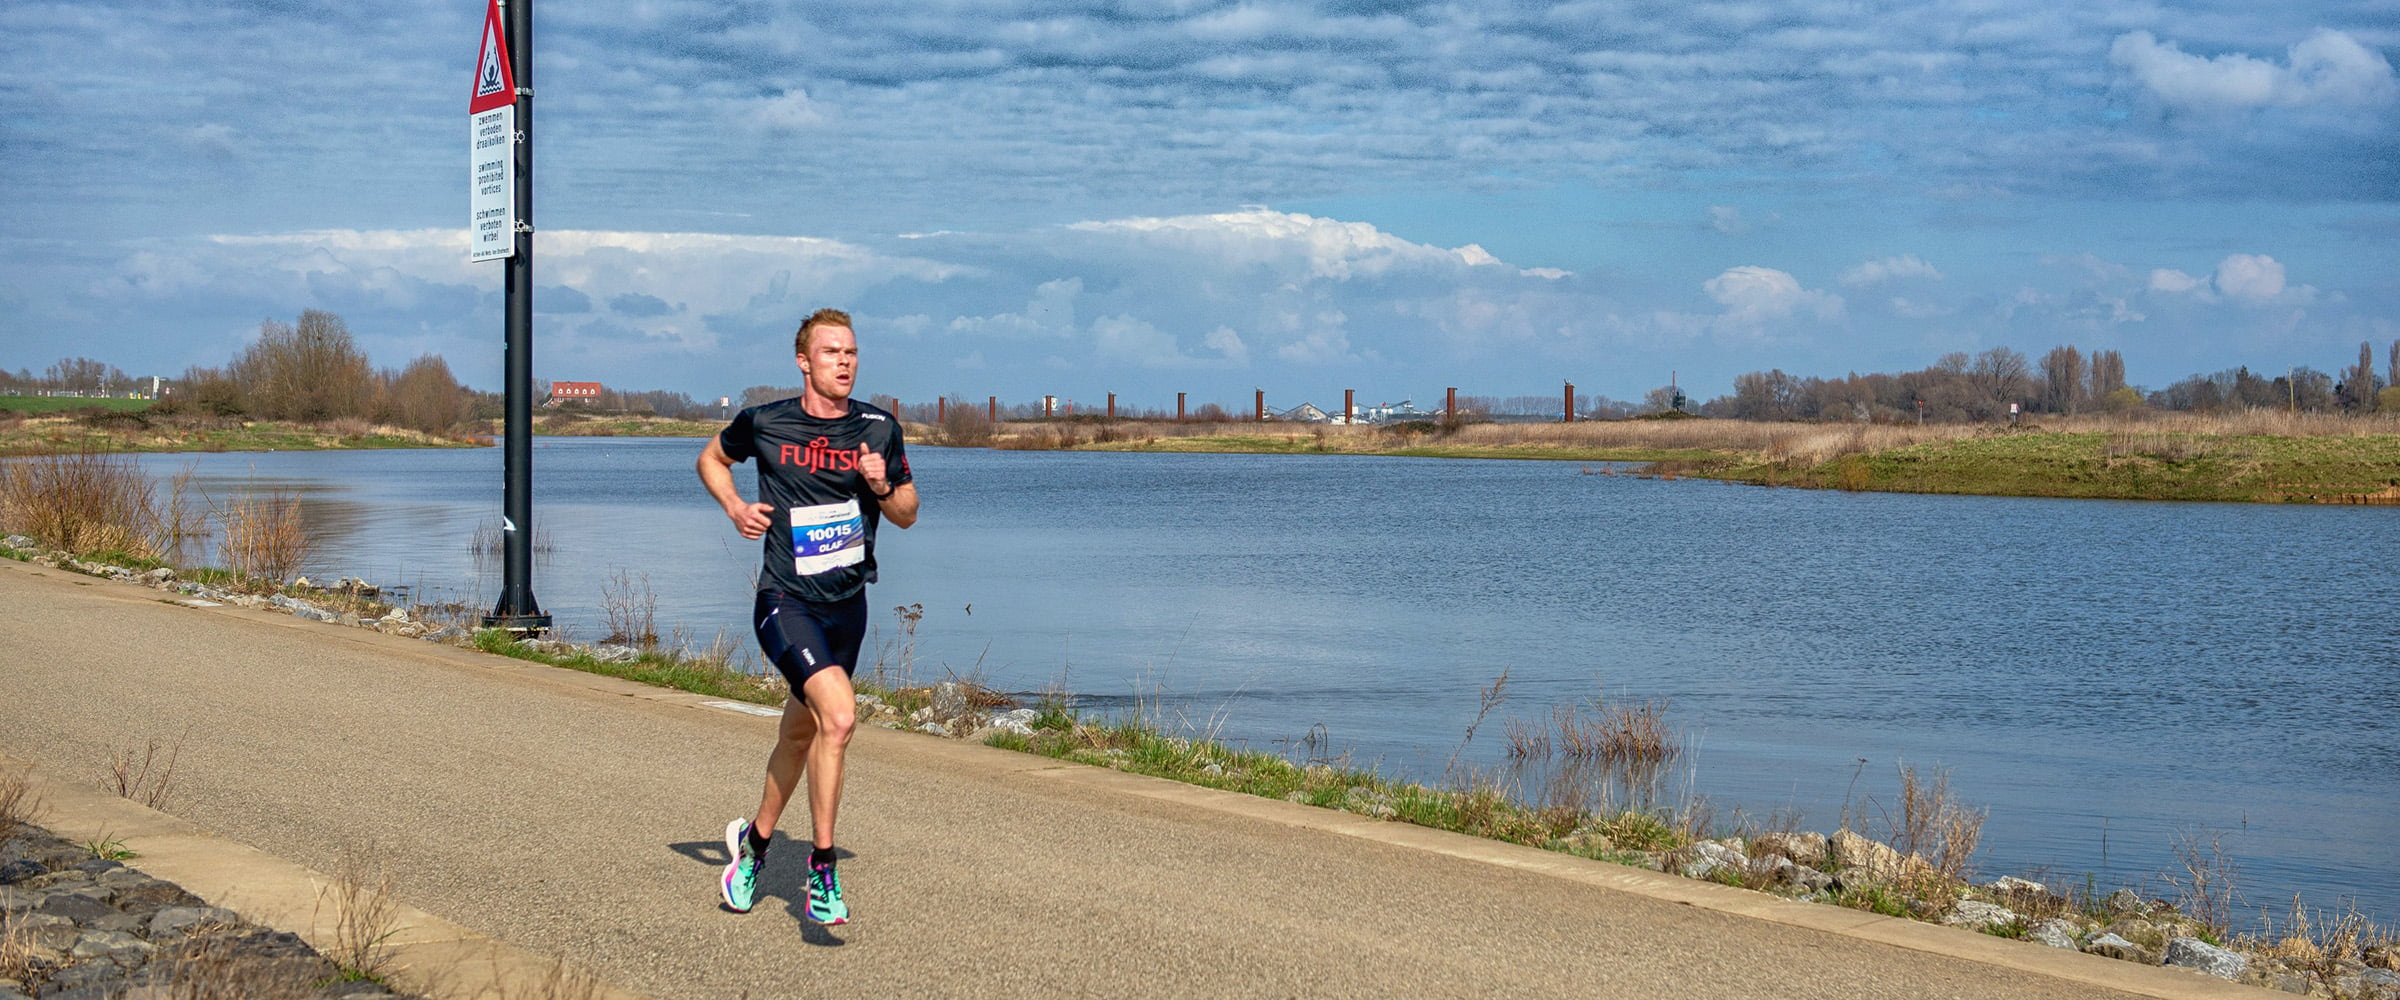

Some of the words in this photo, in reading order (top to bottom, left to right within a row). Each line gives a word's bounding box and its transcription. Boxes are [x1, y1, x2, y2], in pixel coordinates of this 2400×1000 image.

[478, 112, 503, 126] zwemmen
[479, 123, 502, 137] verboden
[476, 134, 505, 150] draaikolken
[478, 159, 503, 174] swimming
[478, 170, 504, 186] prohibited
[481, 184, 501, 196] vortices
[476, 207, 506, 220] schwimmen
[480, 218, 502, 231] verboten
[483, 230, 499, 242] wirbel
[806, 523, 852, 542] 10015
[818, 540, 843, 553] OLAF
